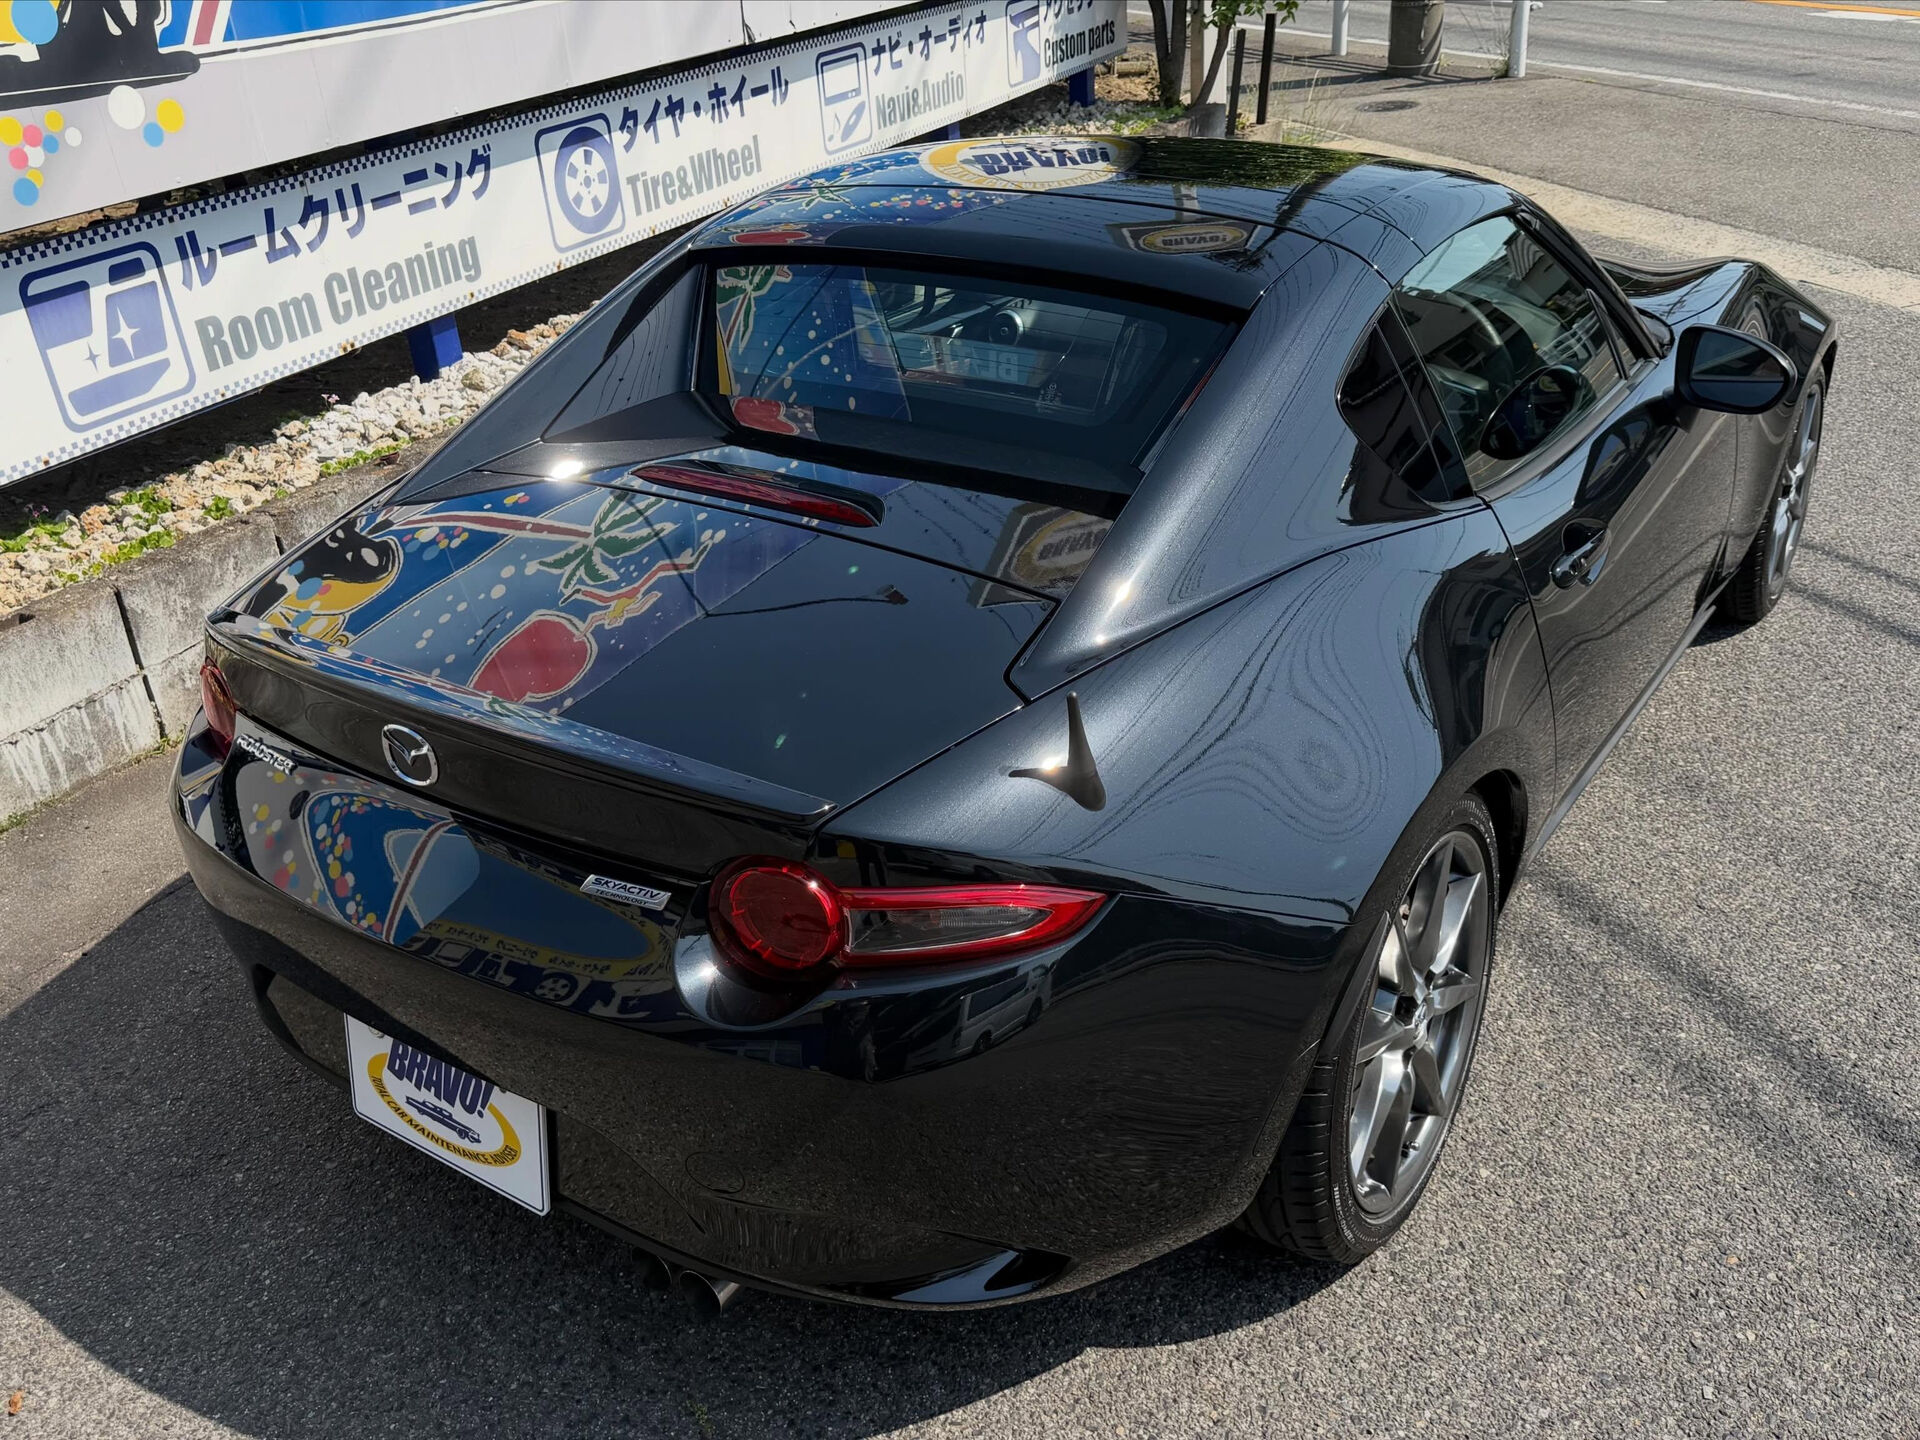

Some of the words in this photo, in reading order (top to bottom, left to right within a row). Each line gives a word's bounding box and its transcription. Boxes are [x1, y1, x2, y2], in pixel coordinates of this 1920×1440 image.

[872, 10, 987, 76] ナビ・オーディオ
[1044, 29, 1086, 68] Custom
[1088, 19, 1115, 55] parts
[619, 66, 789, 154] タイヤ・ホイール
[875, 71, 964, 130] Navi&Audio
[626, 134, 762, 217] Tire&Wheel
[175, 143, 492, 292] ルームクリーニング
[195, 292, 323, 373] Room
[324, 236, 482, 325] Cleaning
[237, 733, 296, 775] ROADSTER
[592, 877, 662, 898] SKYACTIV
[595, 889, 649, 905] TECHNOLOGY
[387, 1039, 495, 1119] BRAVO!
[387, 1101, 408, 1118] CAR
[407, 1118, 492, 1164] MAINTENANCE
